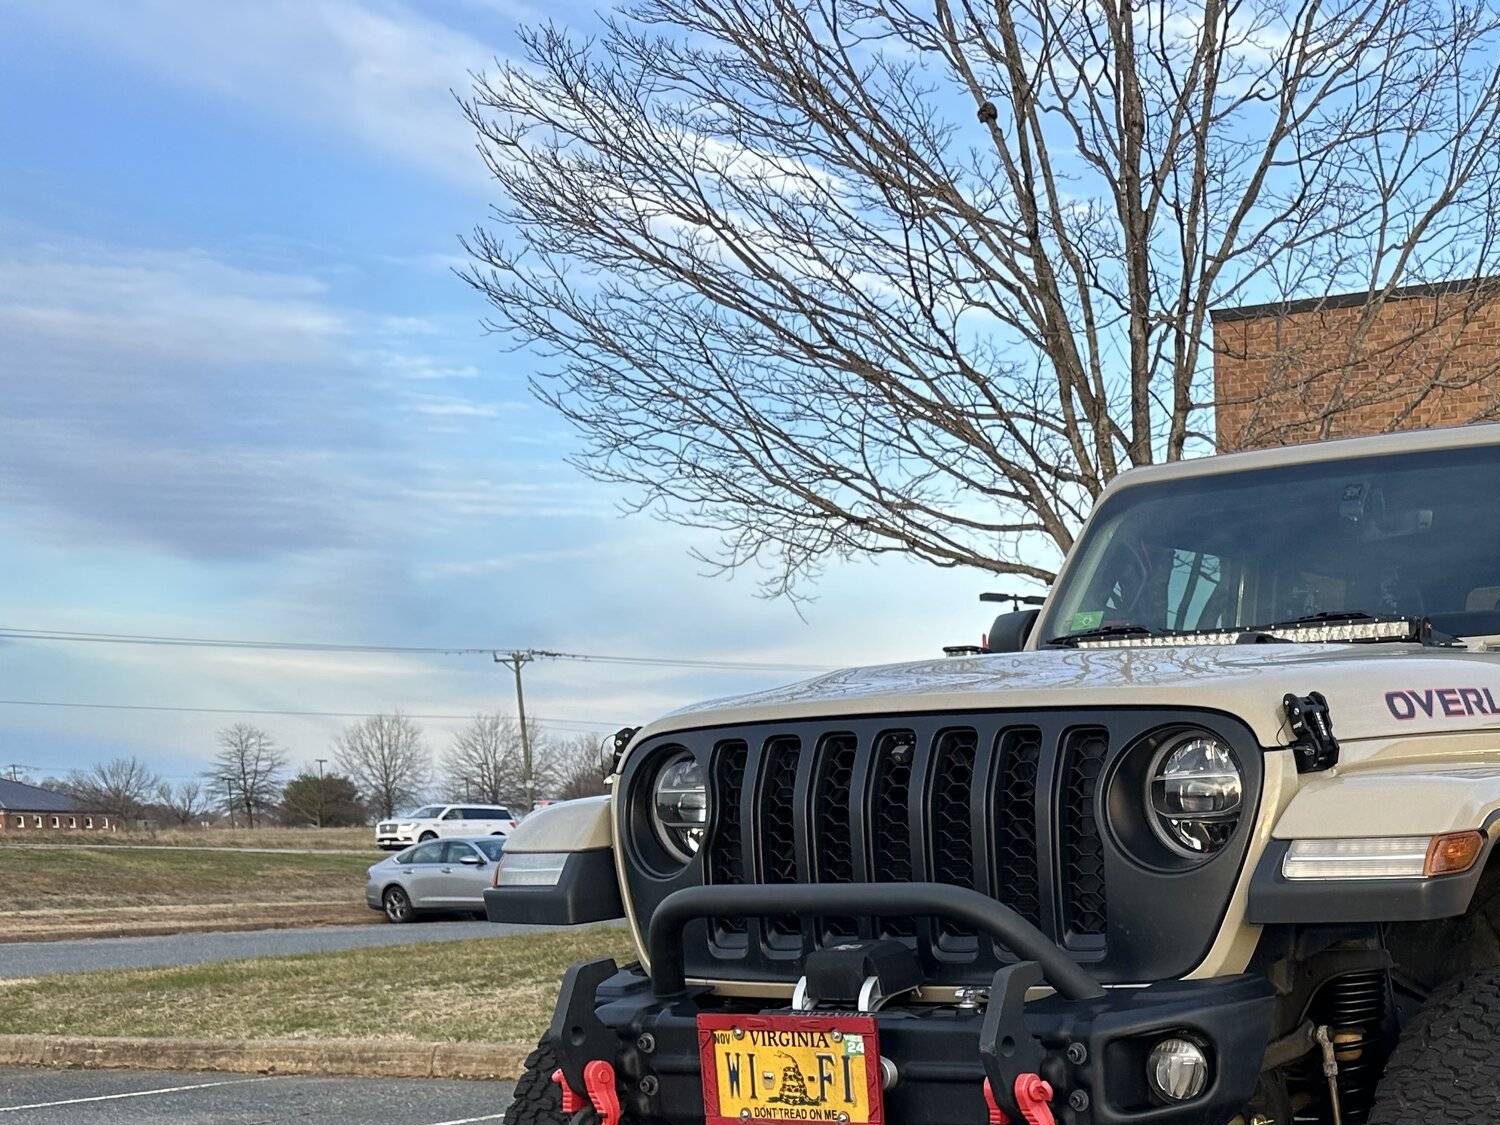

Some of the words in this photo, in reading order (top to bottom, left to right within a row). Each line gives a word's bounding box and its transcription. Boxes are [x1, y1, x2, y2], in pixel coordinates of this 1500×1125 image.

[714, 1033, 731, 1045] NOV
[750, 1031, 830, 1048] VIRGINIA
[847, 1041, 864, 1053] 24
[779, 1108, 807, 1120] TREAD
[811, 1109, 823, 1120] ON
[825, 1110, 838, 1121] ME
